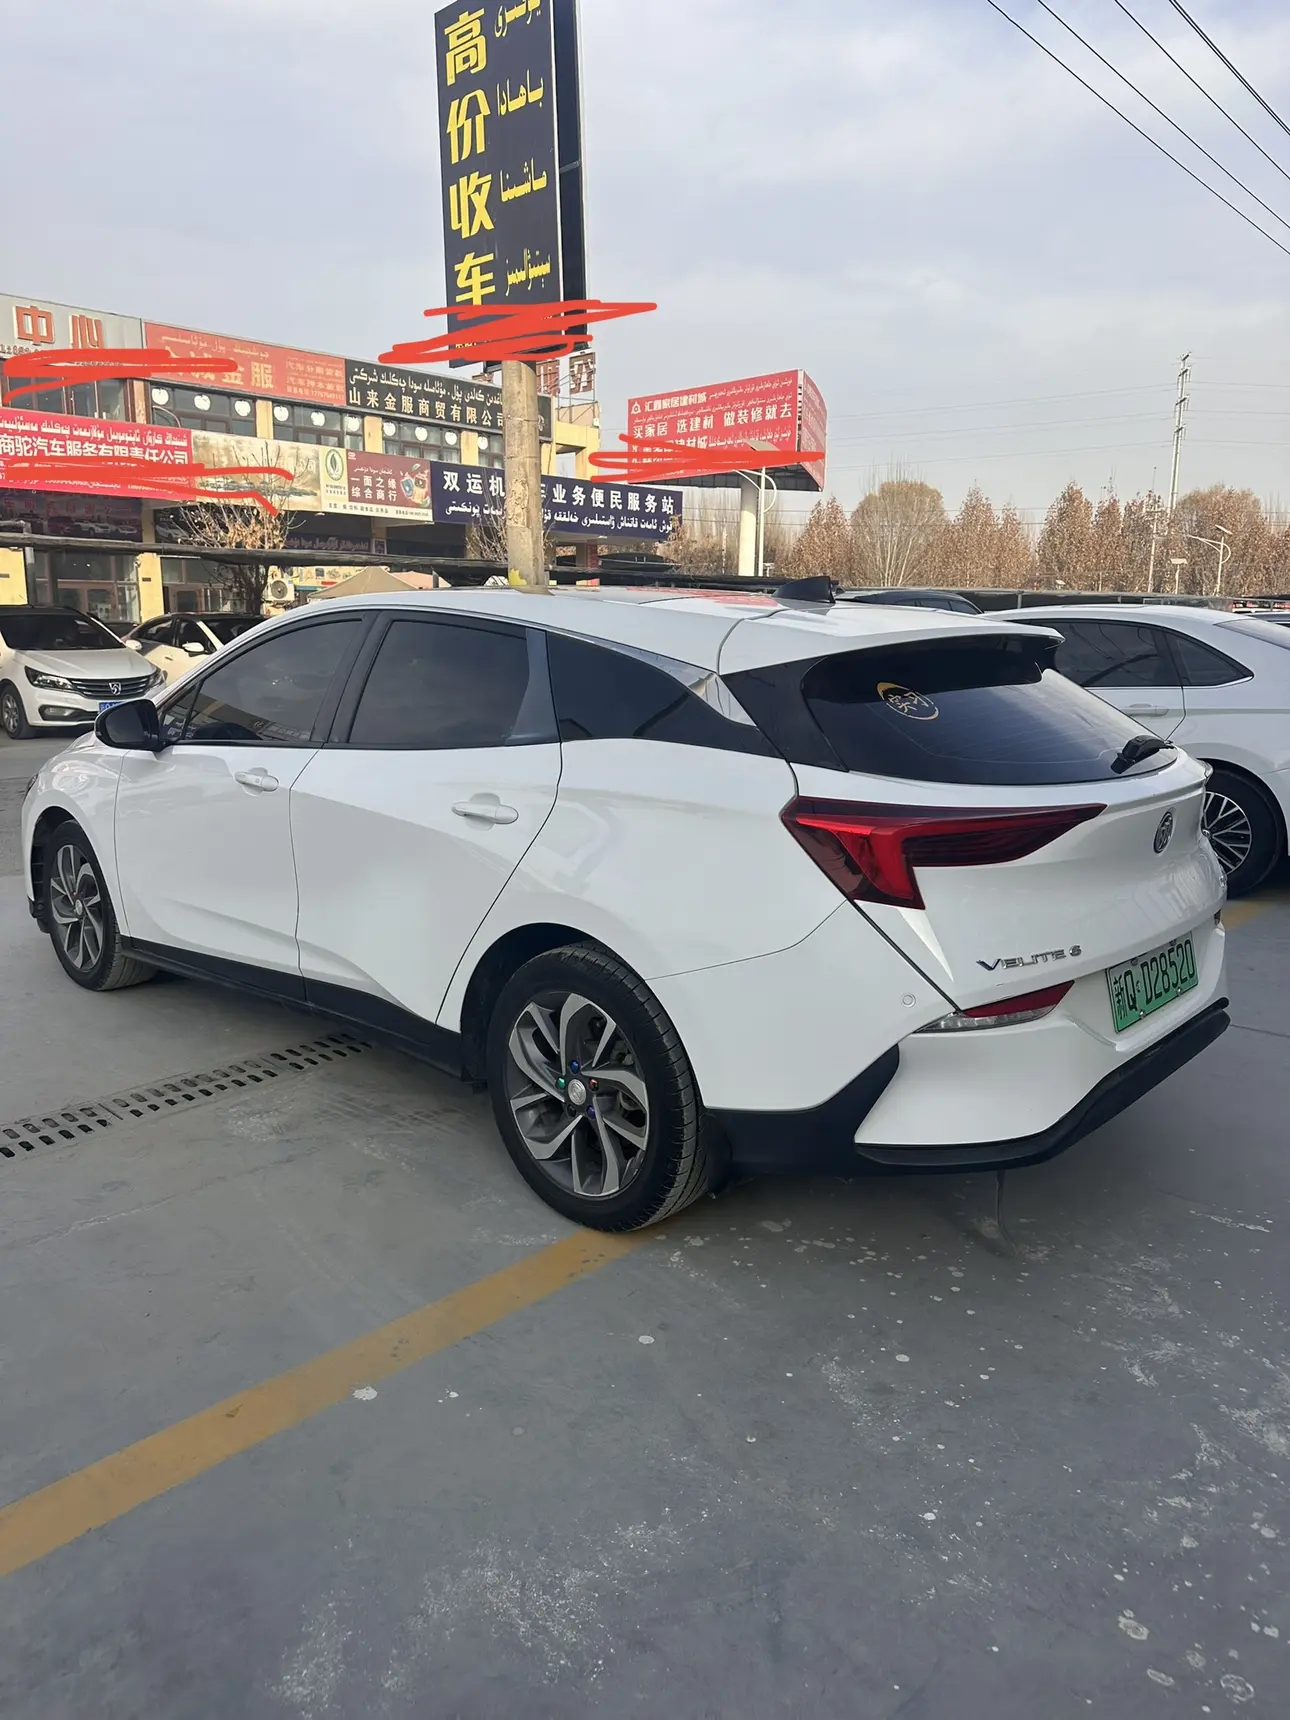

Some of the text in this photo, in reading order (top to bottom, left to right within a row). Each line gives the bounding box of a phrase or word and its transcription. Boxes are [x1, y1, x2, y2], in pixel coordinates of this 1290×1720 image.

[444, 8, 496, 307] 高价收车
[349, 386, 503, 427] 山来金服商贸有限公司
[632, 421, 669, 439] 买家居
[723, 402, 793, 427] 做装修就去
[350, 475, 397, 489] 一面之缘
[351, 486, 397, 502] 综合商行
[443, 470, 675, 515] 双运机业务便民服务站
[976, 944, 1082, 971] VELITE 6
